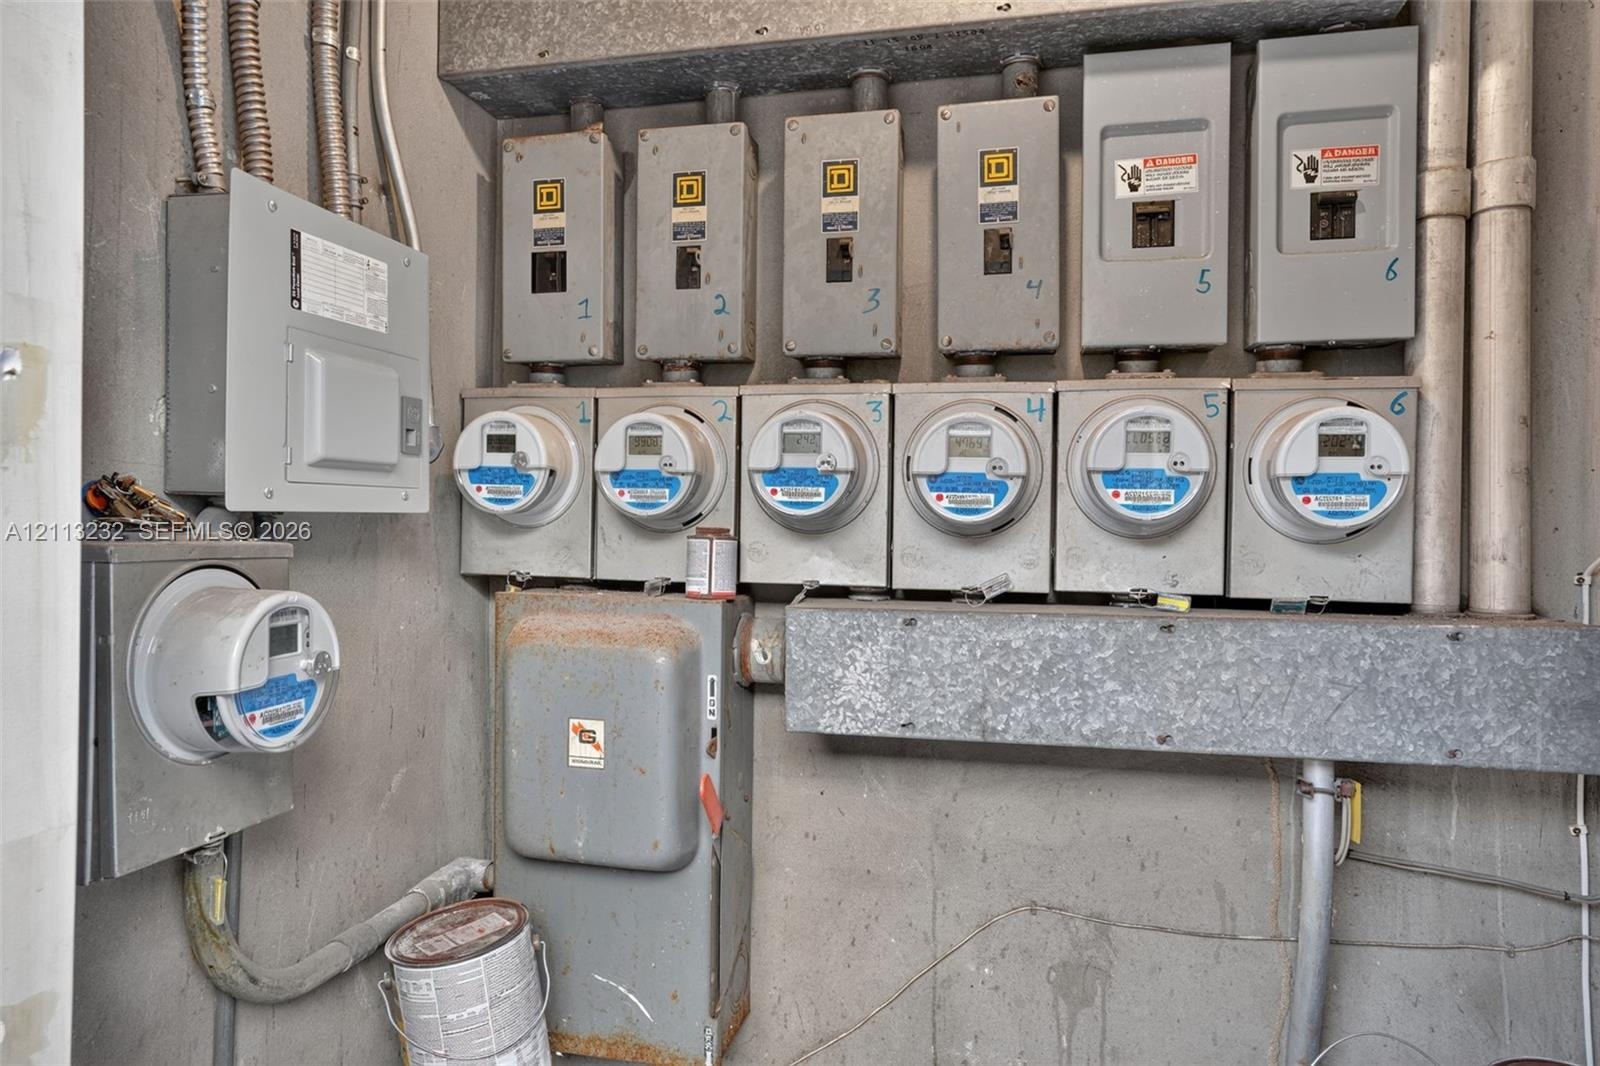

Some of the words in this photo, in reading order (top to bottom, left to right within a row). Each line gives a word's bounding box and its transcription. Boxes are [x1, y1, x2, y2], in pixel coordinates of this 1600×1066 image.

[1155, 156, 1195, 166] DANGER
[1334, 147, 1376, 157] DANGER
[1385, 257, 1399, 281] 6
[1026, 279, 1043, 300] 4
[1196, 269, 1211, 294] 5
[577, 298, 592, 320] 1
[713, 294, 730, 315] 2
[862, 288, 881, 314] 3
[575, 400, 591, 424] 1
[712, 400, 733, 422] 2
[866, 401, 883, 423] 3
[1026, 397, 1046, 422] 4
[1203, 393, 1219, 418] 5
[1390, 391, 1408, 416] 6
[708, 698, 716, 717] ON
